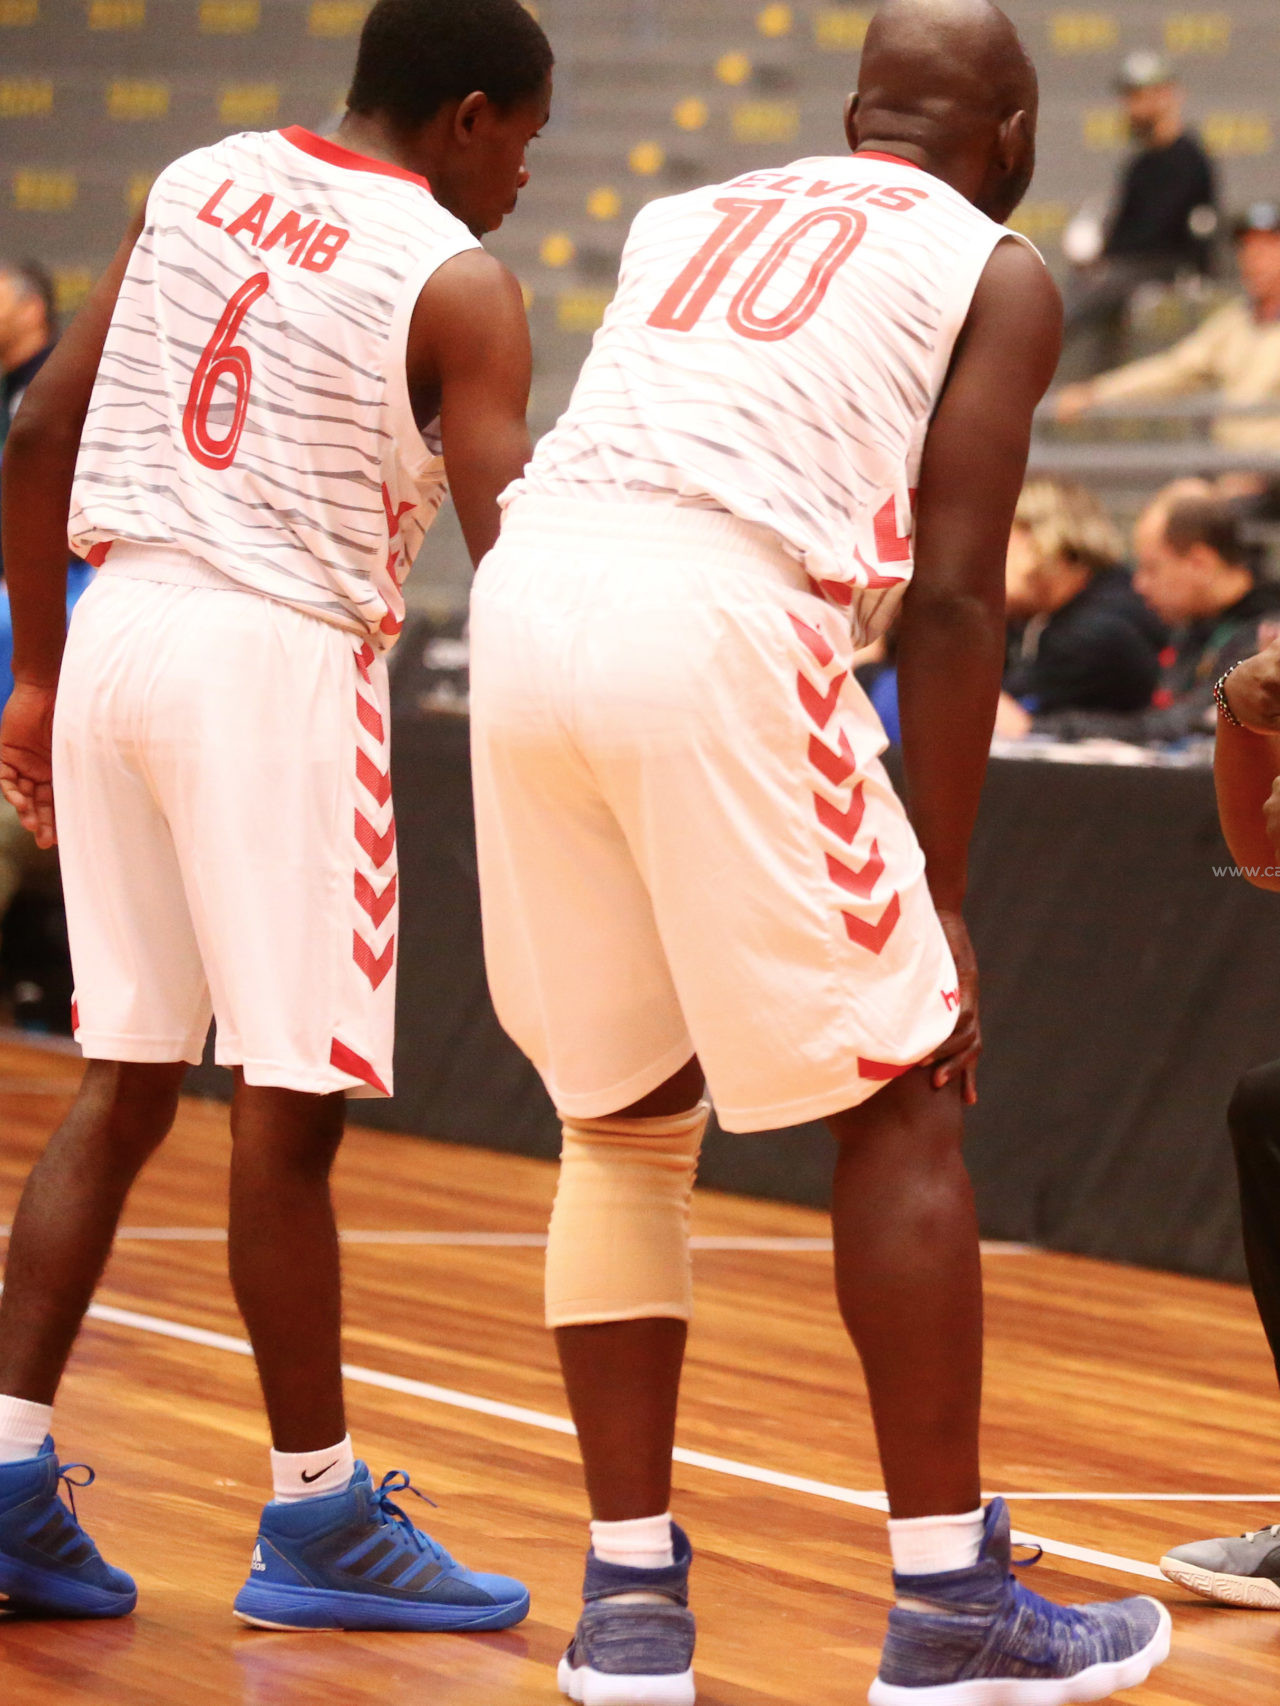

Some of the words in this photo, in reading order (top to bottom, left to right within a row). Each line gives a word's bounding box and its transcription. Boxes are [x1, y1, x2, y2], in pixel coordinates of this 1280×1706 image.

[196, 178, 350, 273] LAMB
[724, 173, 930, 212] ELVIS
[645, 197, 868, 342] 10
[182, 271, 270, 471] 6
